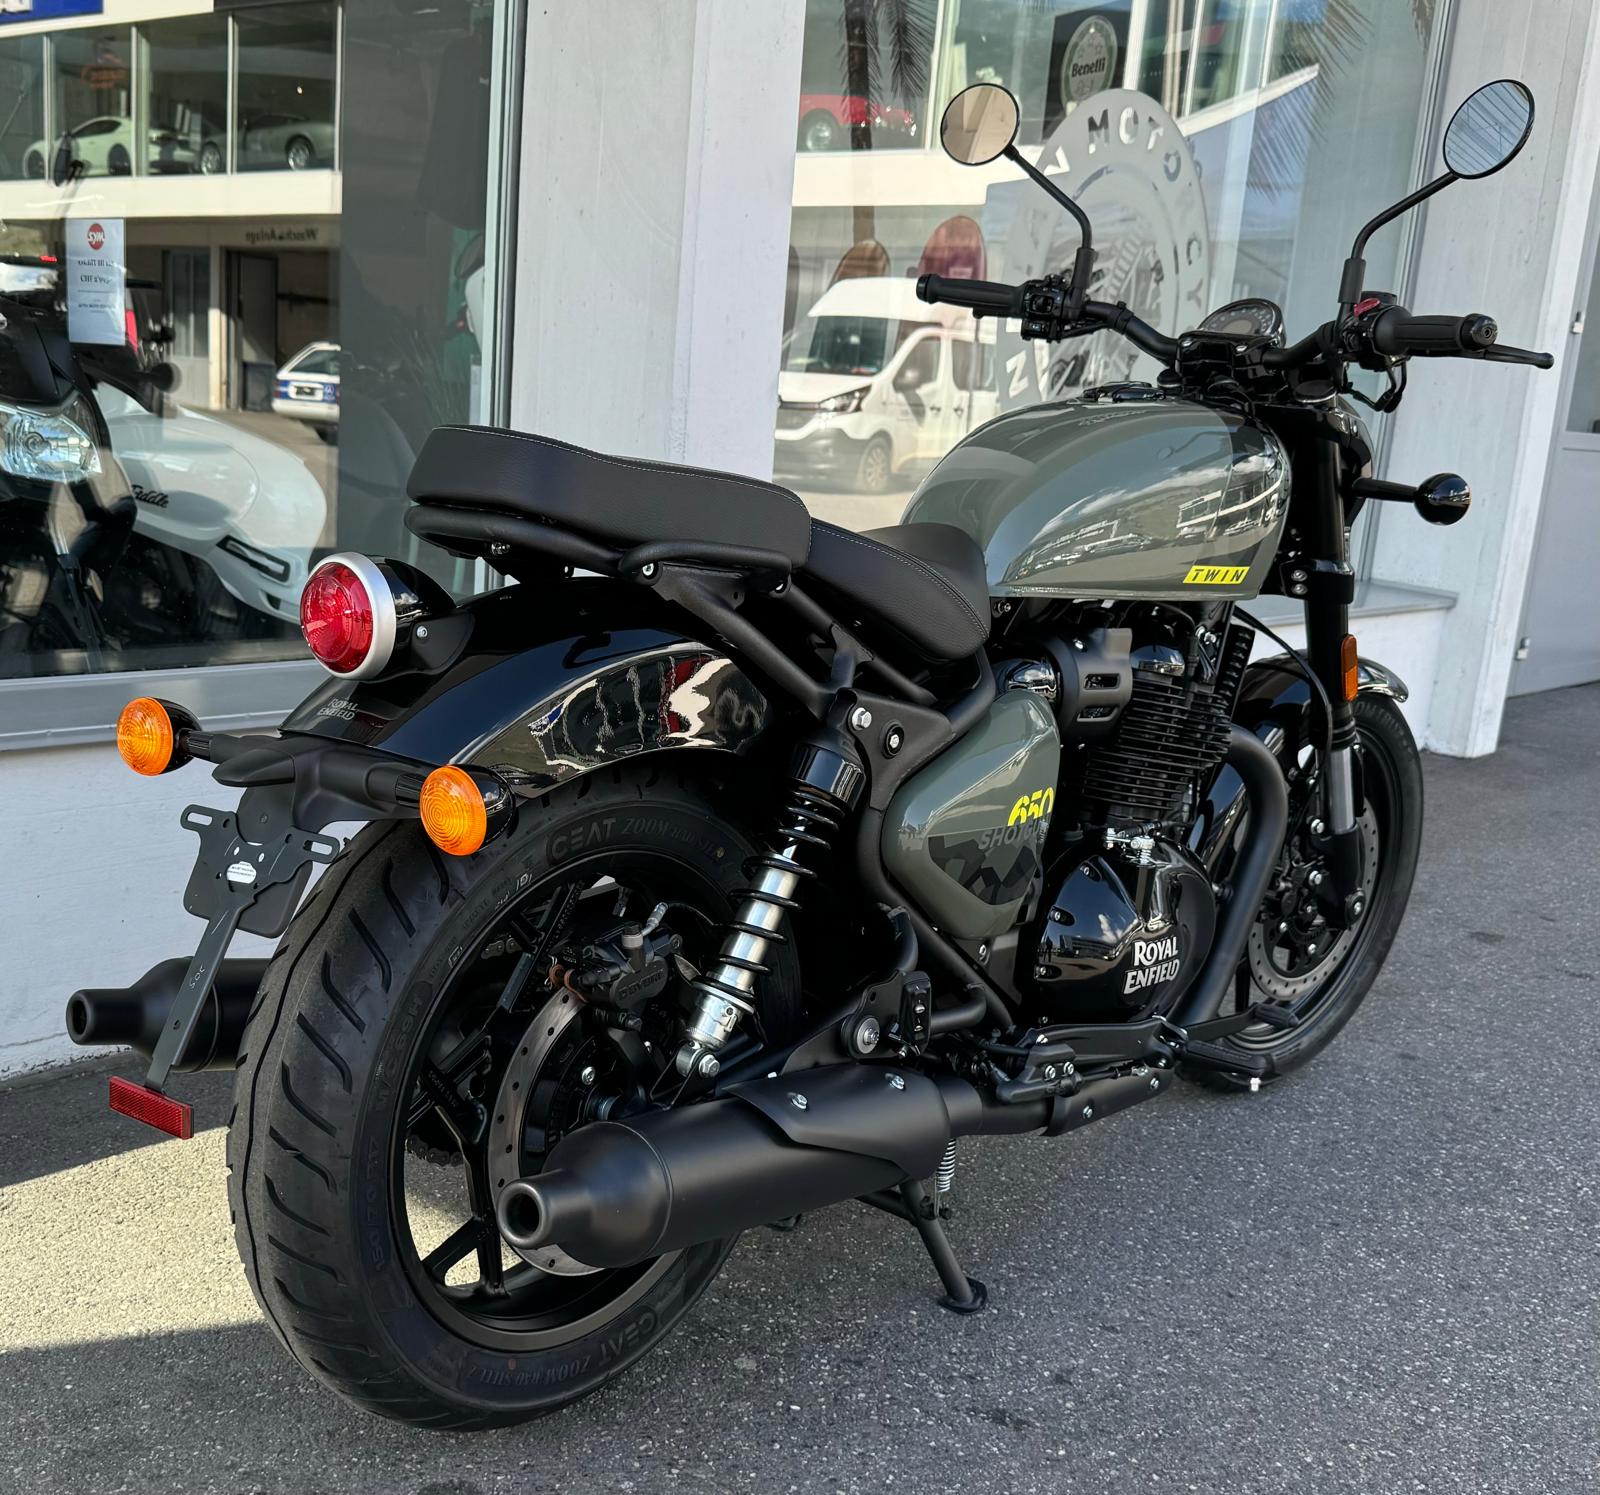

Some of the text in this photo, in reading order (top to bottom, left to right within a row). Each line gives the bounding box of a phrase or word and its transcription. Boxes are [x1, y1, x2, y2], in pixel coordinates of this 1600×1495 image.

[1071, 57, 1106, 78] Benelli
[87, 231, 106, 245] SYM
[131, 484, 169, 508] Fiddle
[1192, 568, 1245, 582] TWIN
[316, 708, 355, 721] ENFIELD
[328, 698, 358, 711] ROYAL
[551, 817, 617, 860] CEAT
[1133, 935, 1179, 967] ROYAL
[1123, 958, 1181, 995] ENFIELD
[598, 1311, 656, 1365] CEAT
